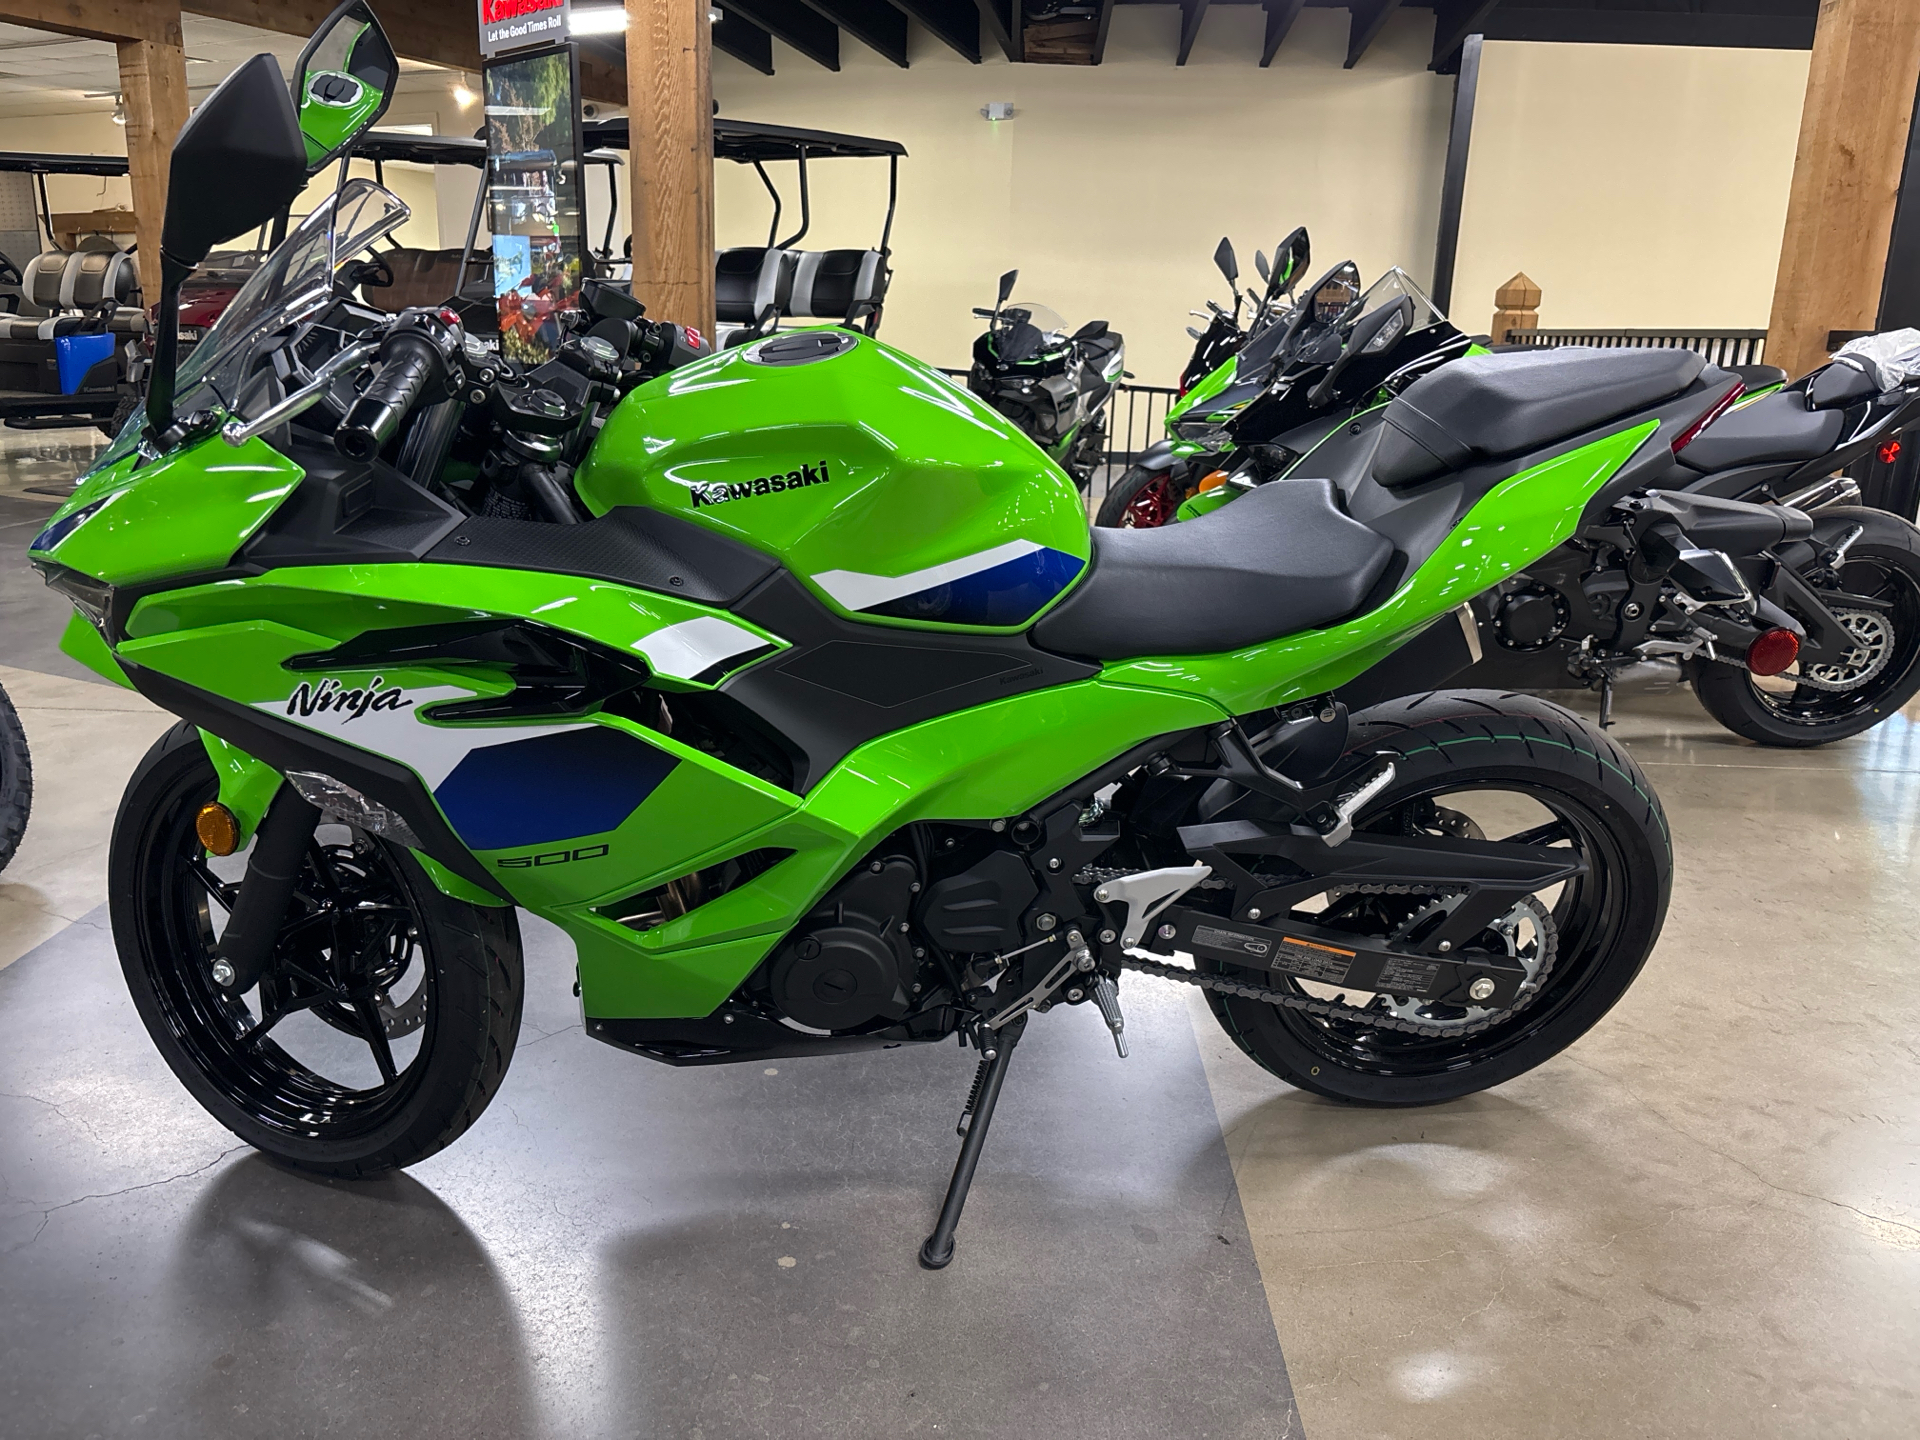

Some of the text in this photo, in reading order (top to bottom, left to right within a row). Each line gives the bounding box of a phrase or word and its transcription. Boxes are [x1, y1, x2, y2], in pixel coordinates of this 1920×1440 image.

[488, 15, 561, 42] Let the Good Times Roll
[689, 460, 830, 508] Kawasaki
[999, 667, 1044, 685] Kawasaki
[286, 676, 414, 725] Ninja
[497, 843, 610, 868] 500
